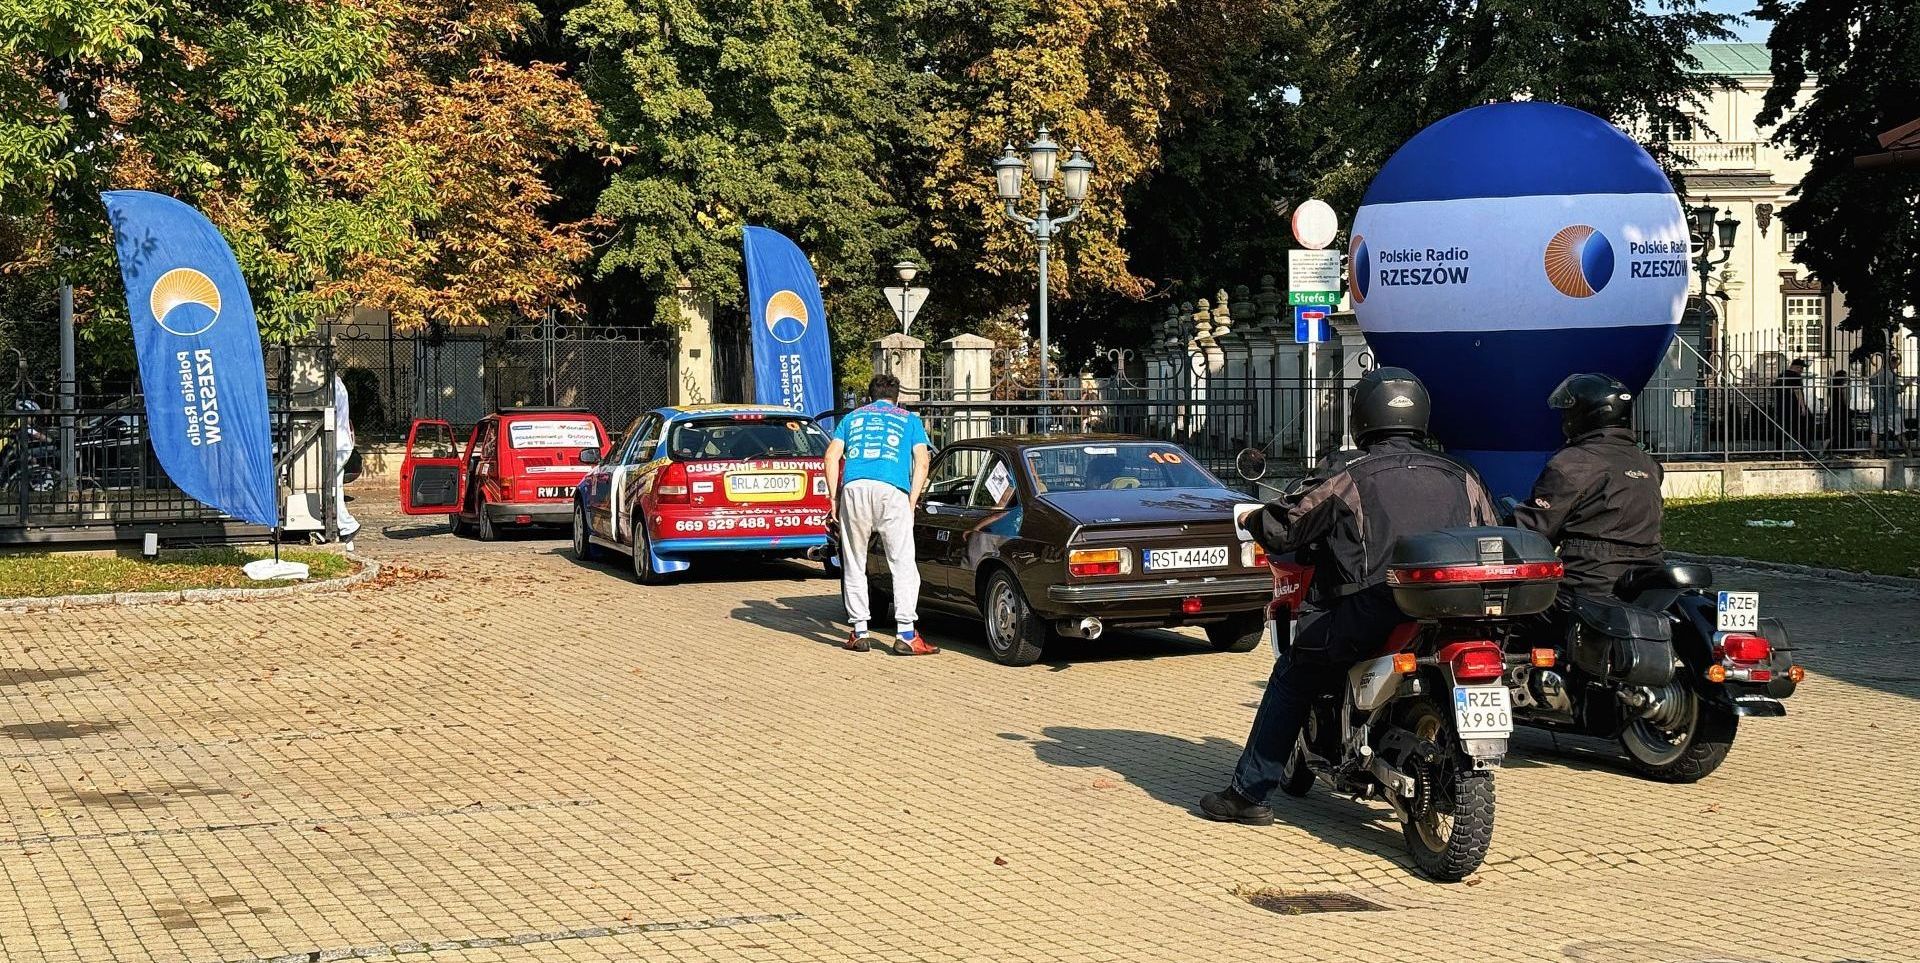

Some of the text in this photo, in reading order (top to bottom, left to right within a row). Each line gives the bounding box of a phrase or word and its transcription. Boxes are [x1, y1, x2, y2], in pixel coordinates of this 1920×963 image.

[1630, 240, 1668, 254] Polskie
[1380, 247, 1469, 263] Polskie Radio
[1380, 262, 1469, 286] RZESZÓW
[1294, 292, 1325, 303] Strefa
[1149, 452, 1181, 464] 10
[686, 461, 758, 472] OSUSZANIE
[737, 477, 797, 490] RLA 20091
[537, 486, 559, 497] RWJ
[675, 520, 704, 532] 669
[707, 518, 735, 531] 929
[774, 515, 801, 528] 530
[1152, 548, 1226, 567] RST 44469
[1728, 597, 1753, 610] RZE
[1721, 614, 1755, 627] 3X34
[1468, 692, 1502, 707] RZE
[1461, 711, 1508, 728] X980
